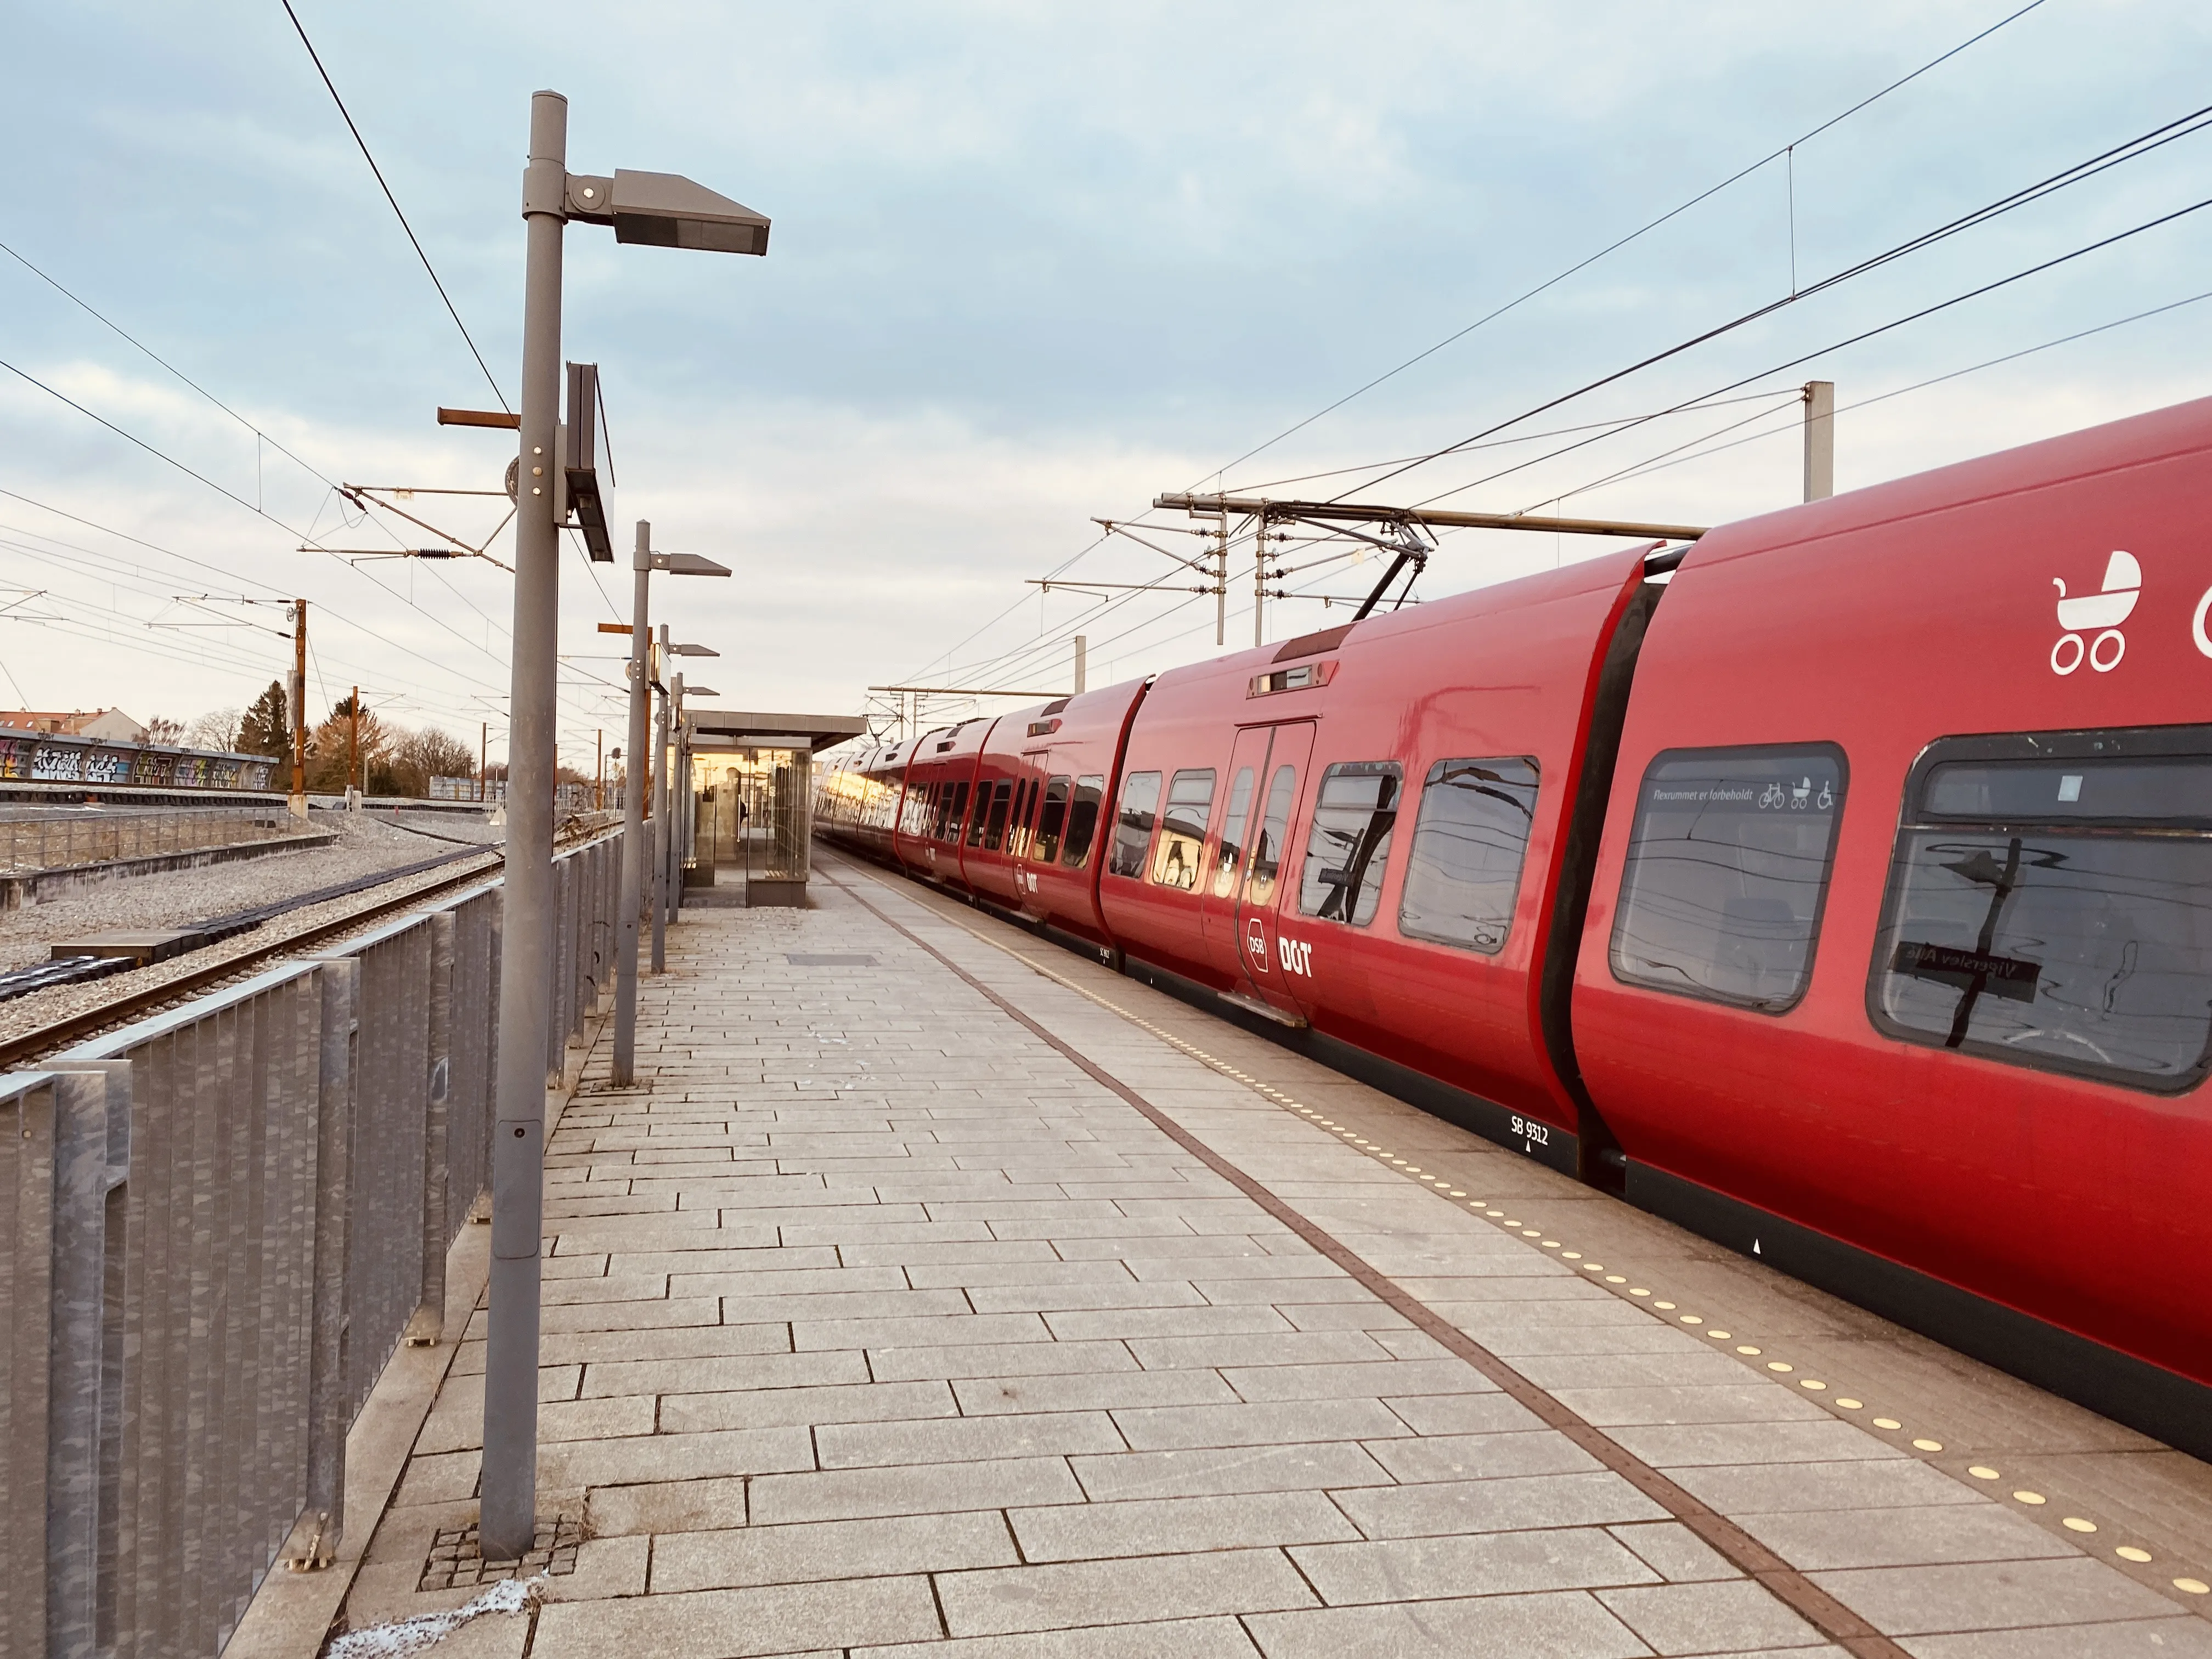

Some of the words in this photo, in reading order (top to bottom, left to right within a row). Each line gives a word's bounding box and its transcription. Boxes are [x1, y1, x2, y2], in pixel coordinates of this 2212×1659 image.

[1699, 792, 1708, 800] er
[1709, 788, 1753, 800] forbeholdt
[1249, 936, 1265, 955] DSB
[1279, 936, 1312, 978] DOT
[1511, 1115, 1523, 1135] SB
[1526, 1121, 1548, 1146] 9312
